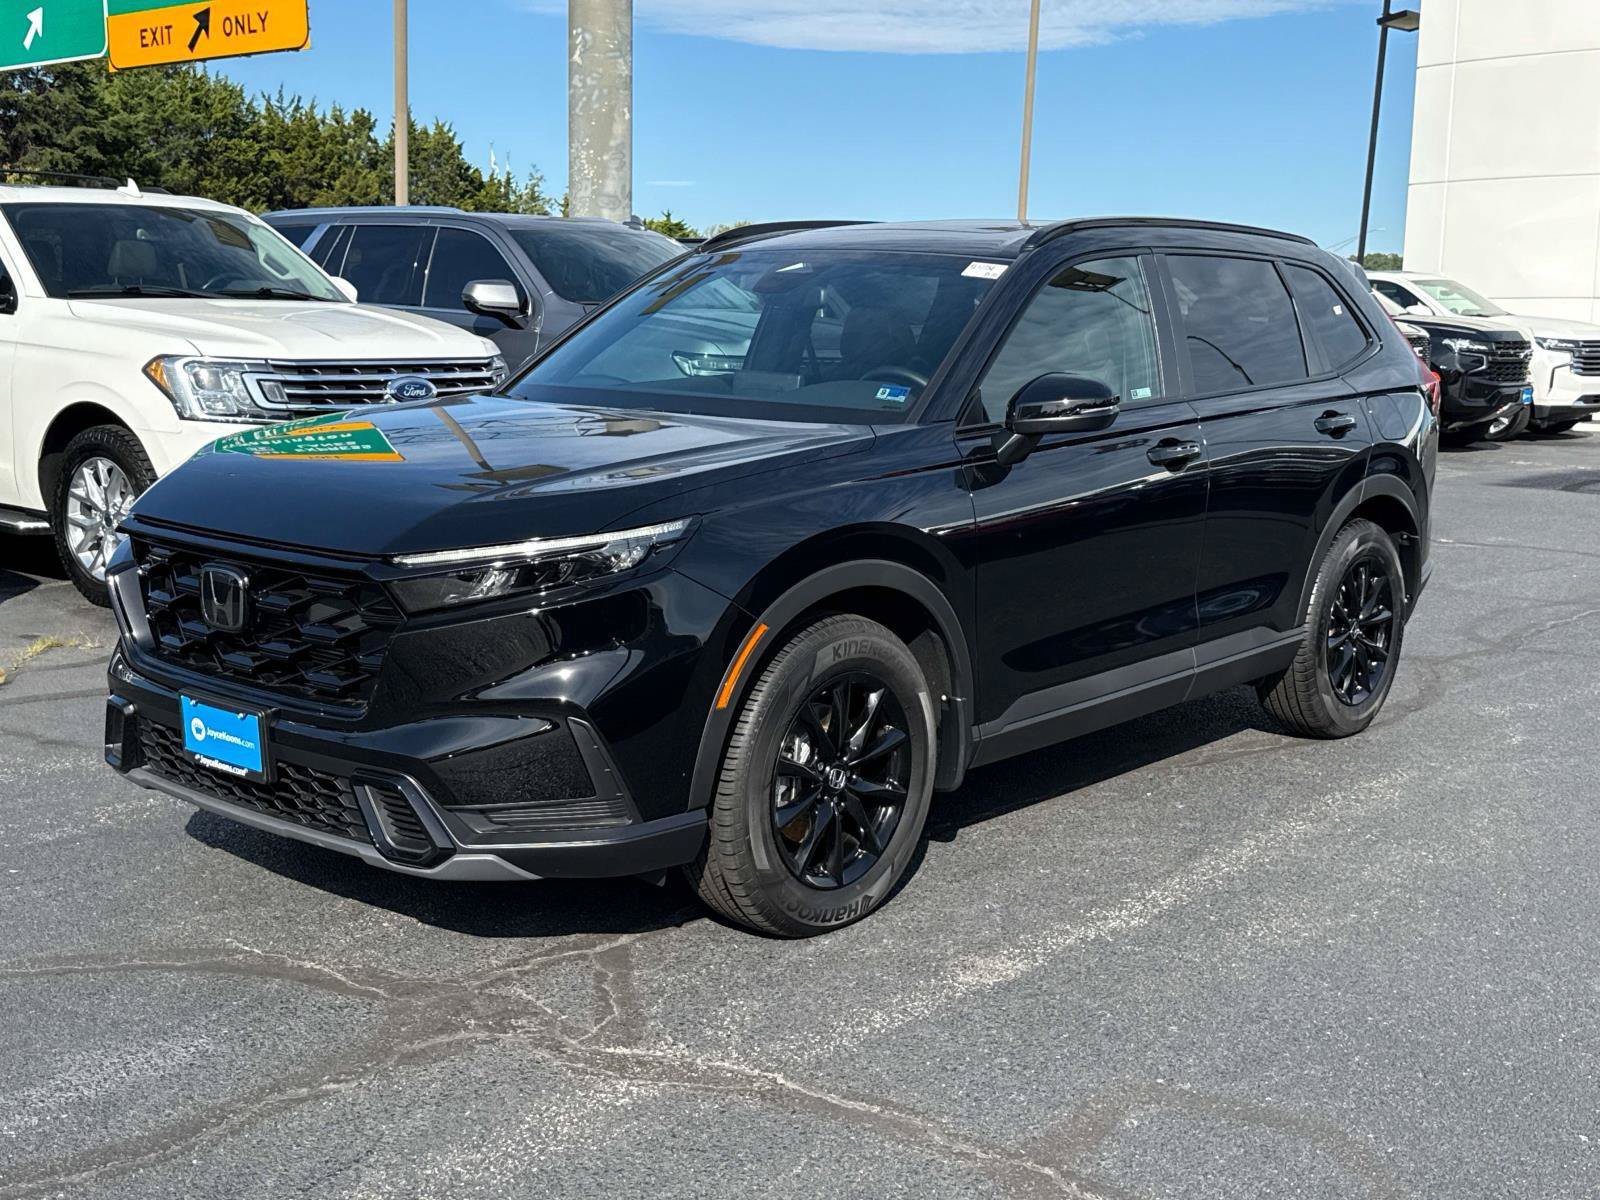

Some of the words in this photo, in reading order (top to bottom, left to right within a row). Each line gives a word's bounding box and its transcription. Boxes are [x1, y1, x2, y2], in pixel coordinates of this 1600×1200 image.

[139, 25, 173, 48] EXIT
[222, 11, 269, 37] ONLY
[403, 384, 426, 397] Ford
